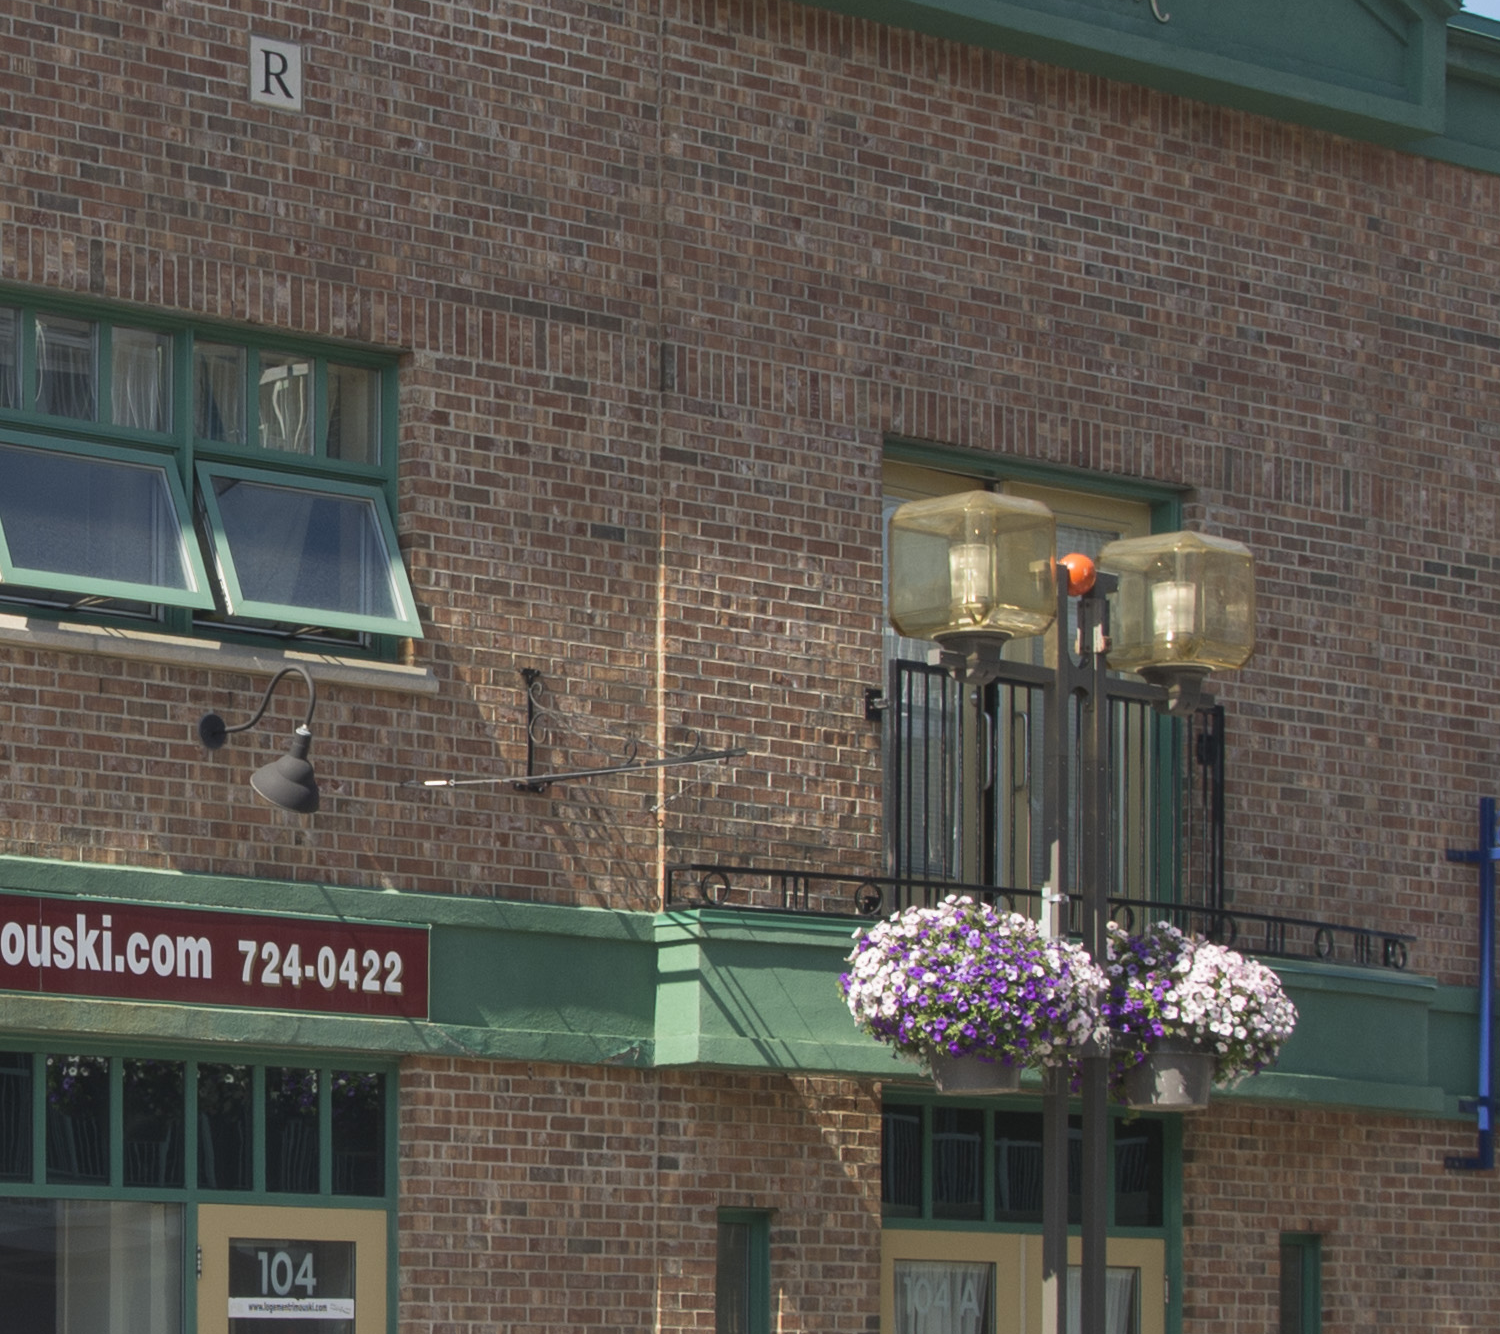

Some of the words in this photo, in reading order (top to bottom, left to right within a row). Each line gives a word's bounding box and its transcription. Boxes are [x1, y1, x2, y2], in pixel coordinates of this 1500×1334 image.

[259, 48, 295, 99] R
[237, 939, 404, 995] 724-0422
[257, 1250, 317, 1296] 104
[903, 1276, 950, 1315] 104
[959, 1278, 981, 1317] A
